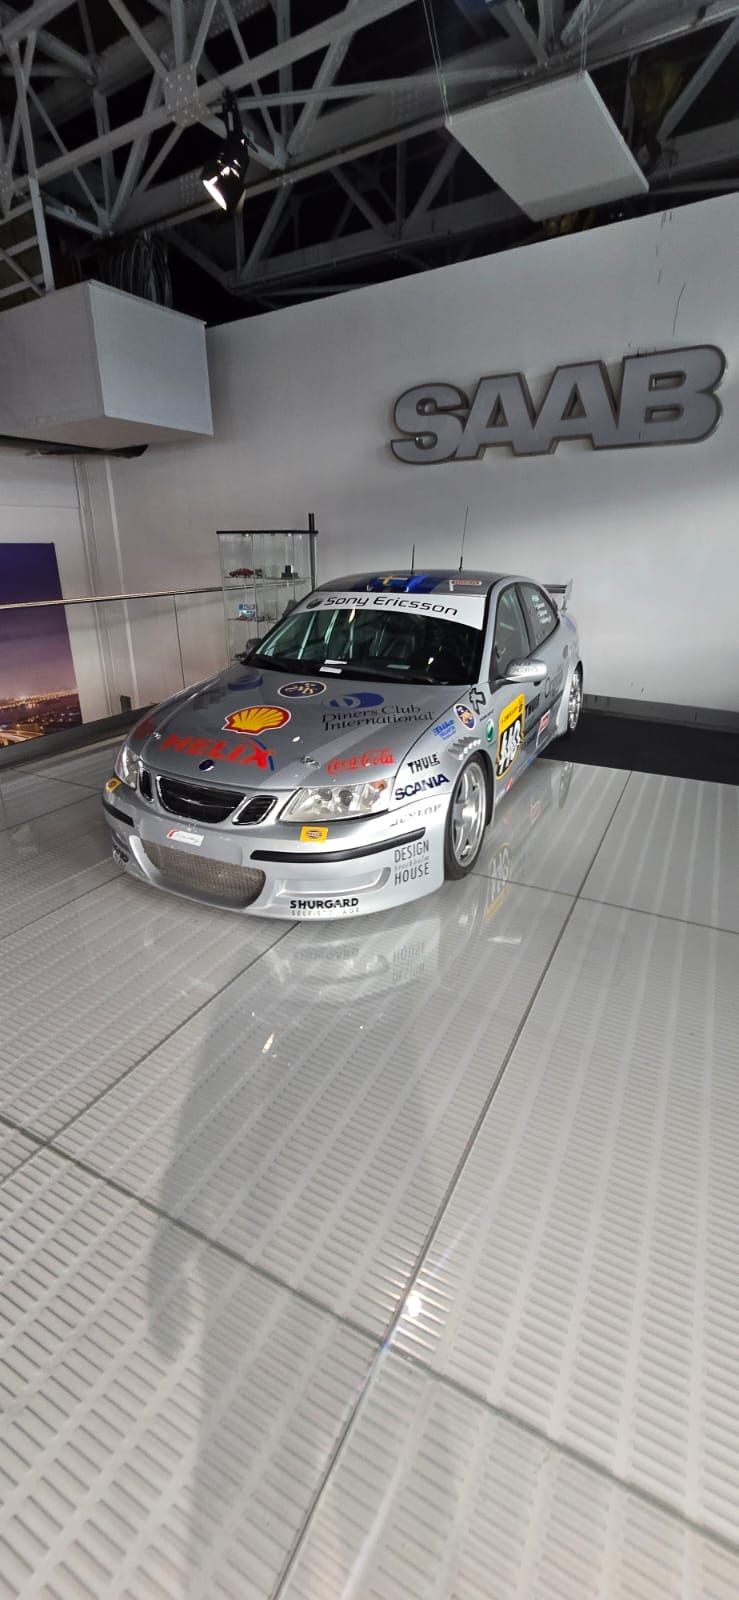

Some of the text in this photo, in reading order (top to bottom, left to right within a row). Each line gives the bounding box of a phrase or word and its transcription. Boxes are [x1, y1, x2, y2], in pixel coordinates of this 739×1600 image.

[390, 344, 727, 465] SAAB
[324, 596, 458, 616] Sony Ericsson
[322, 704, 421, 723] Diners Club
[325, 711, 433, 731] International
[160, 733, 274, 769] HELIX
[407, 753, 441, 774] THULE
[395, 773, 450, 801] SCANIA
[395, 839, 429, 863] DESIGN
[395, 862, 429, 886] HOUSE
[290, 897, 359, 909] SHURGARD
